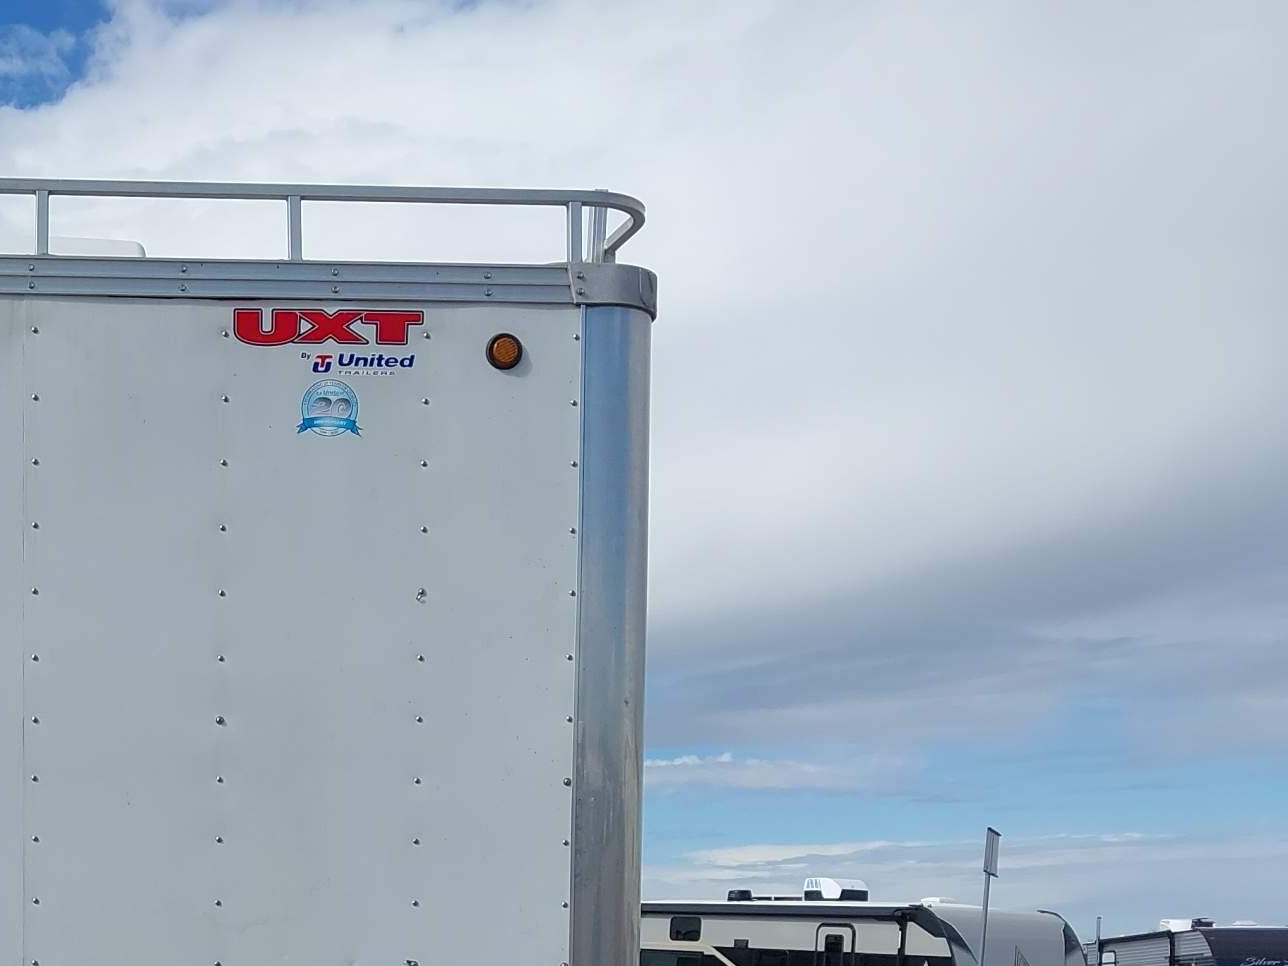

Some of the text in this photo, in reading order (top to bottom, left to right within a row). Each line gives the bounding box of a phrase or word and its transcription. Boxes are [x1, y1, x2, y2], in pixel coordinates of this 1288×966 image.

[233, 308, 425, 347] UXT
[300, 352, 311, 360] By
[338, 353, 416, 368] United
